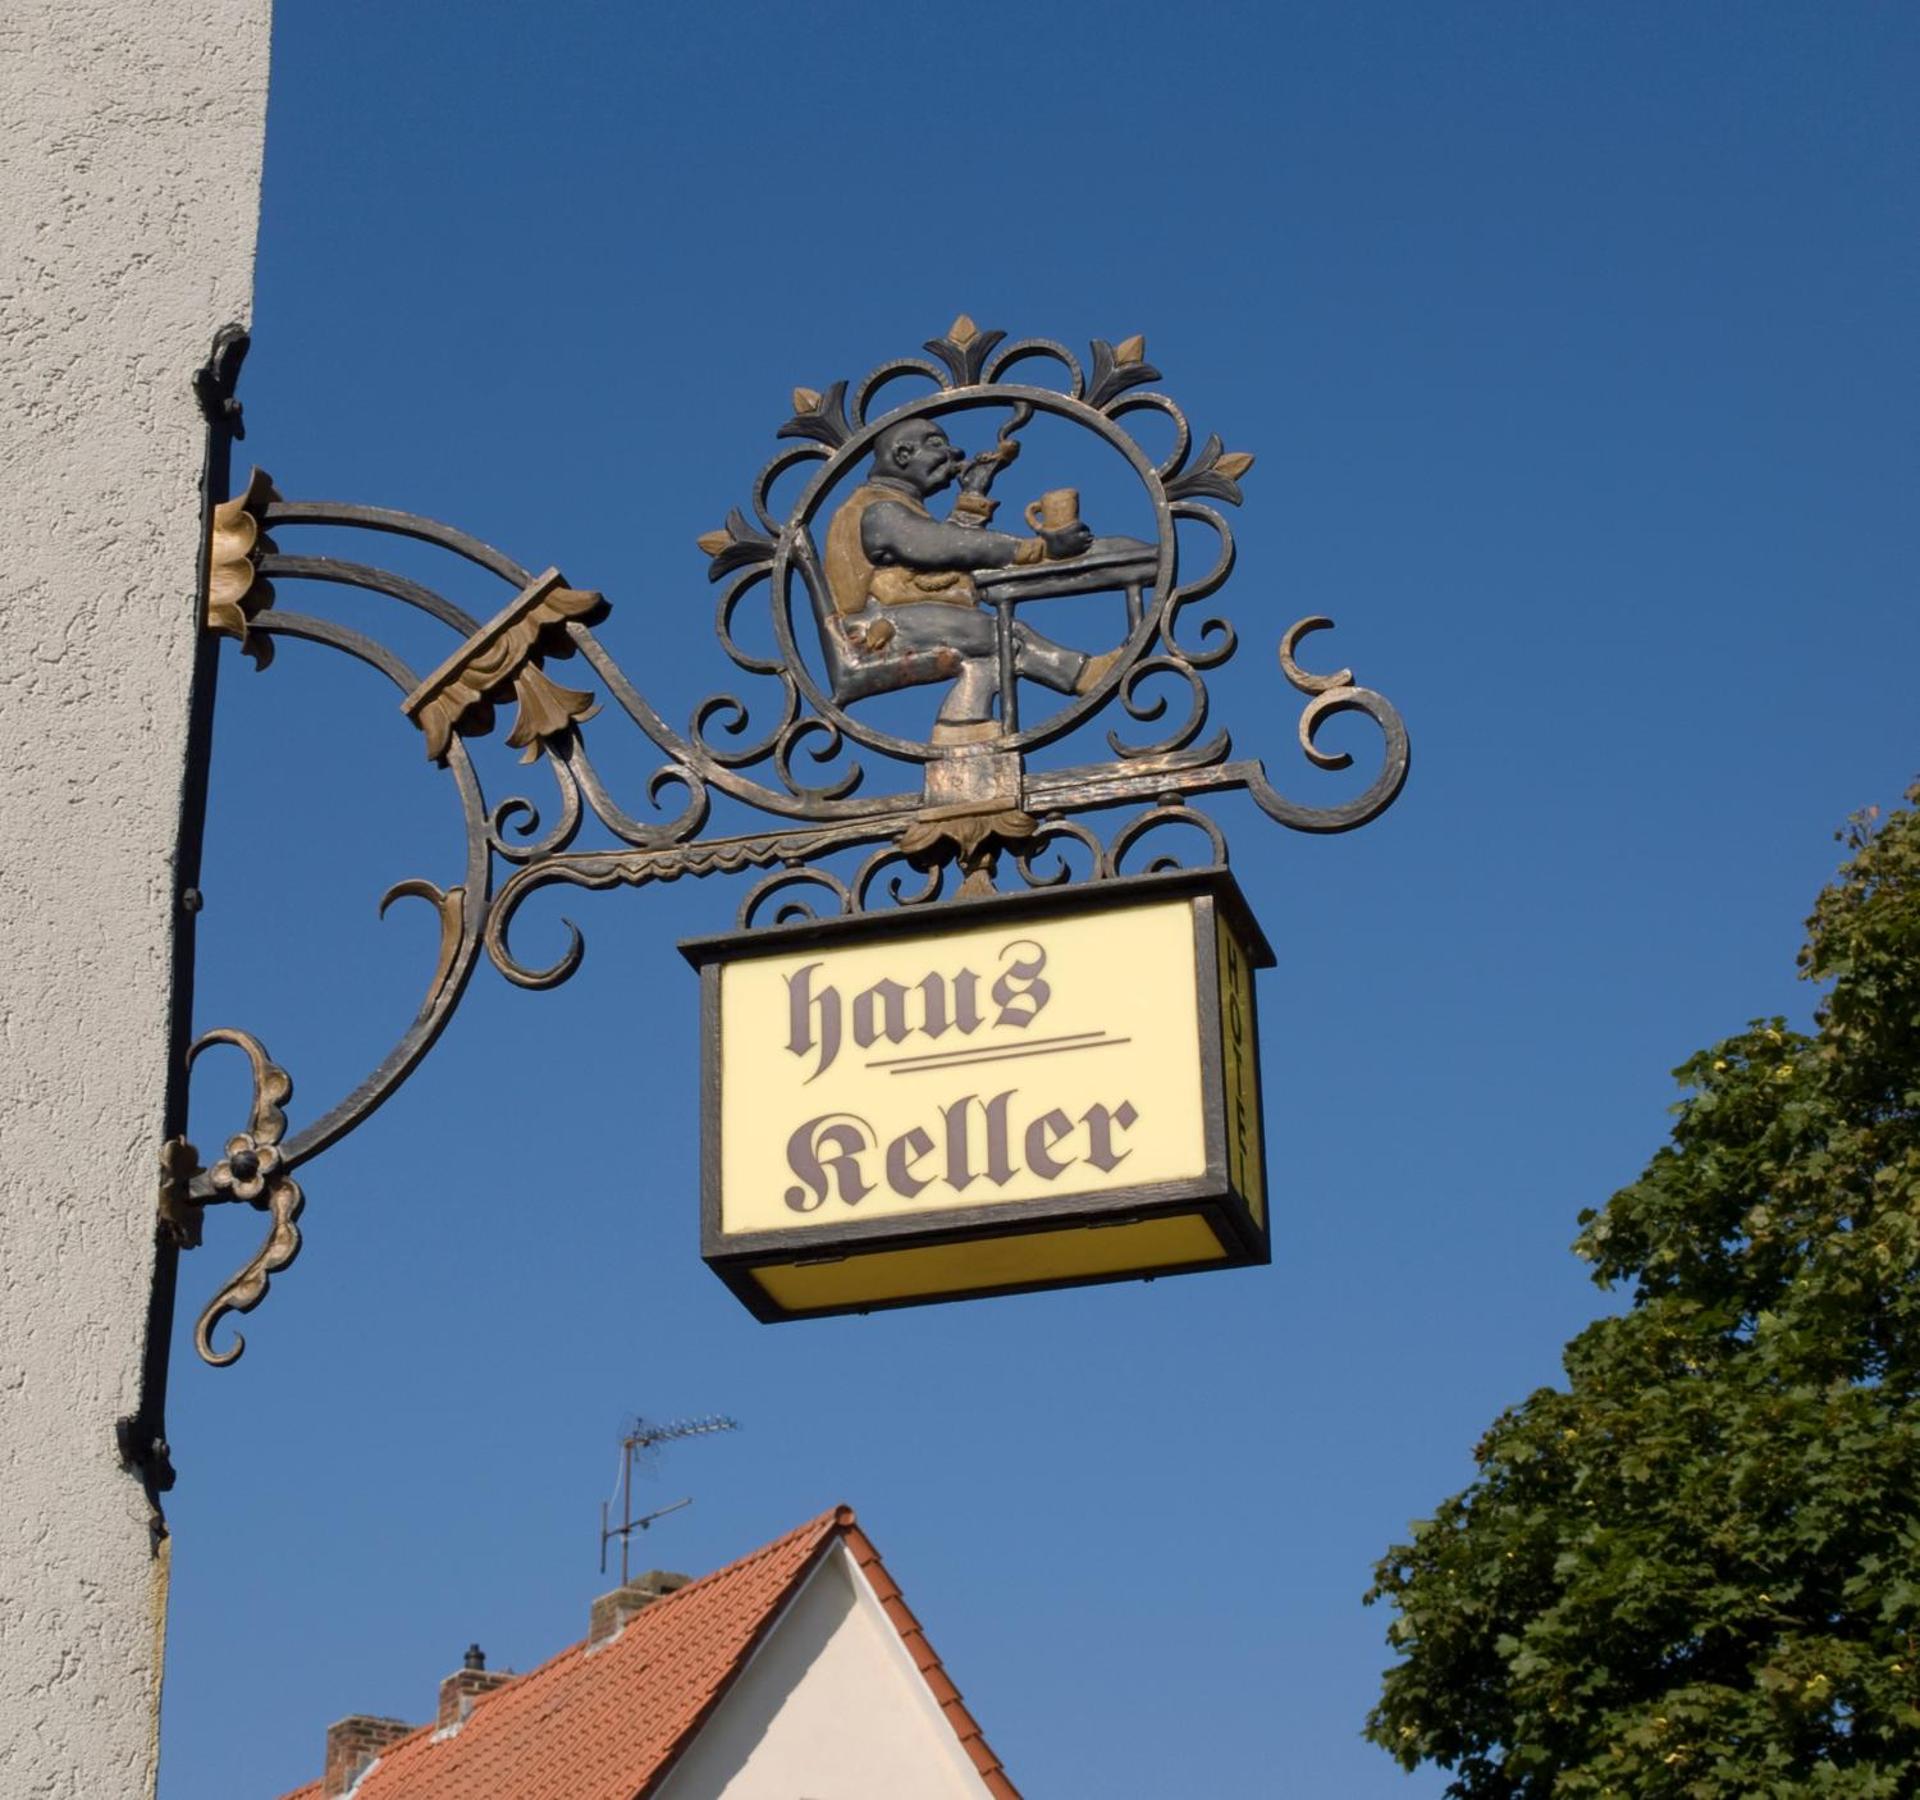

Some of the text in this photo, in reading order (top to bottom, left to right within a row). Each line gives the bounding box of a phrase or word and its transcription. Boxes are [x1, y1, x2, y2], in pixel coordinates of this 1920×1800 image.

[781, 939, 1052, 1085] haus
[1226, 937, 1250, 1208] HOTEL
[783, 1088, 1140, 1213] Keller
